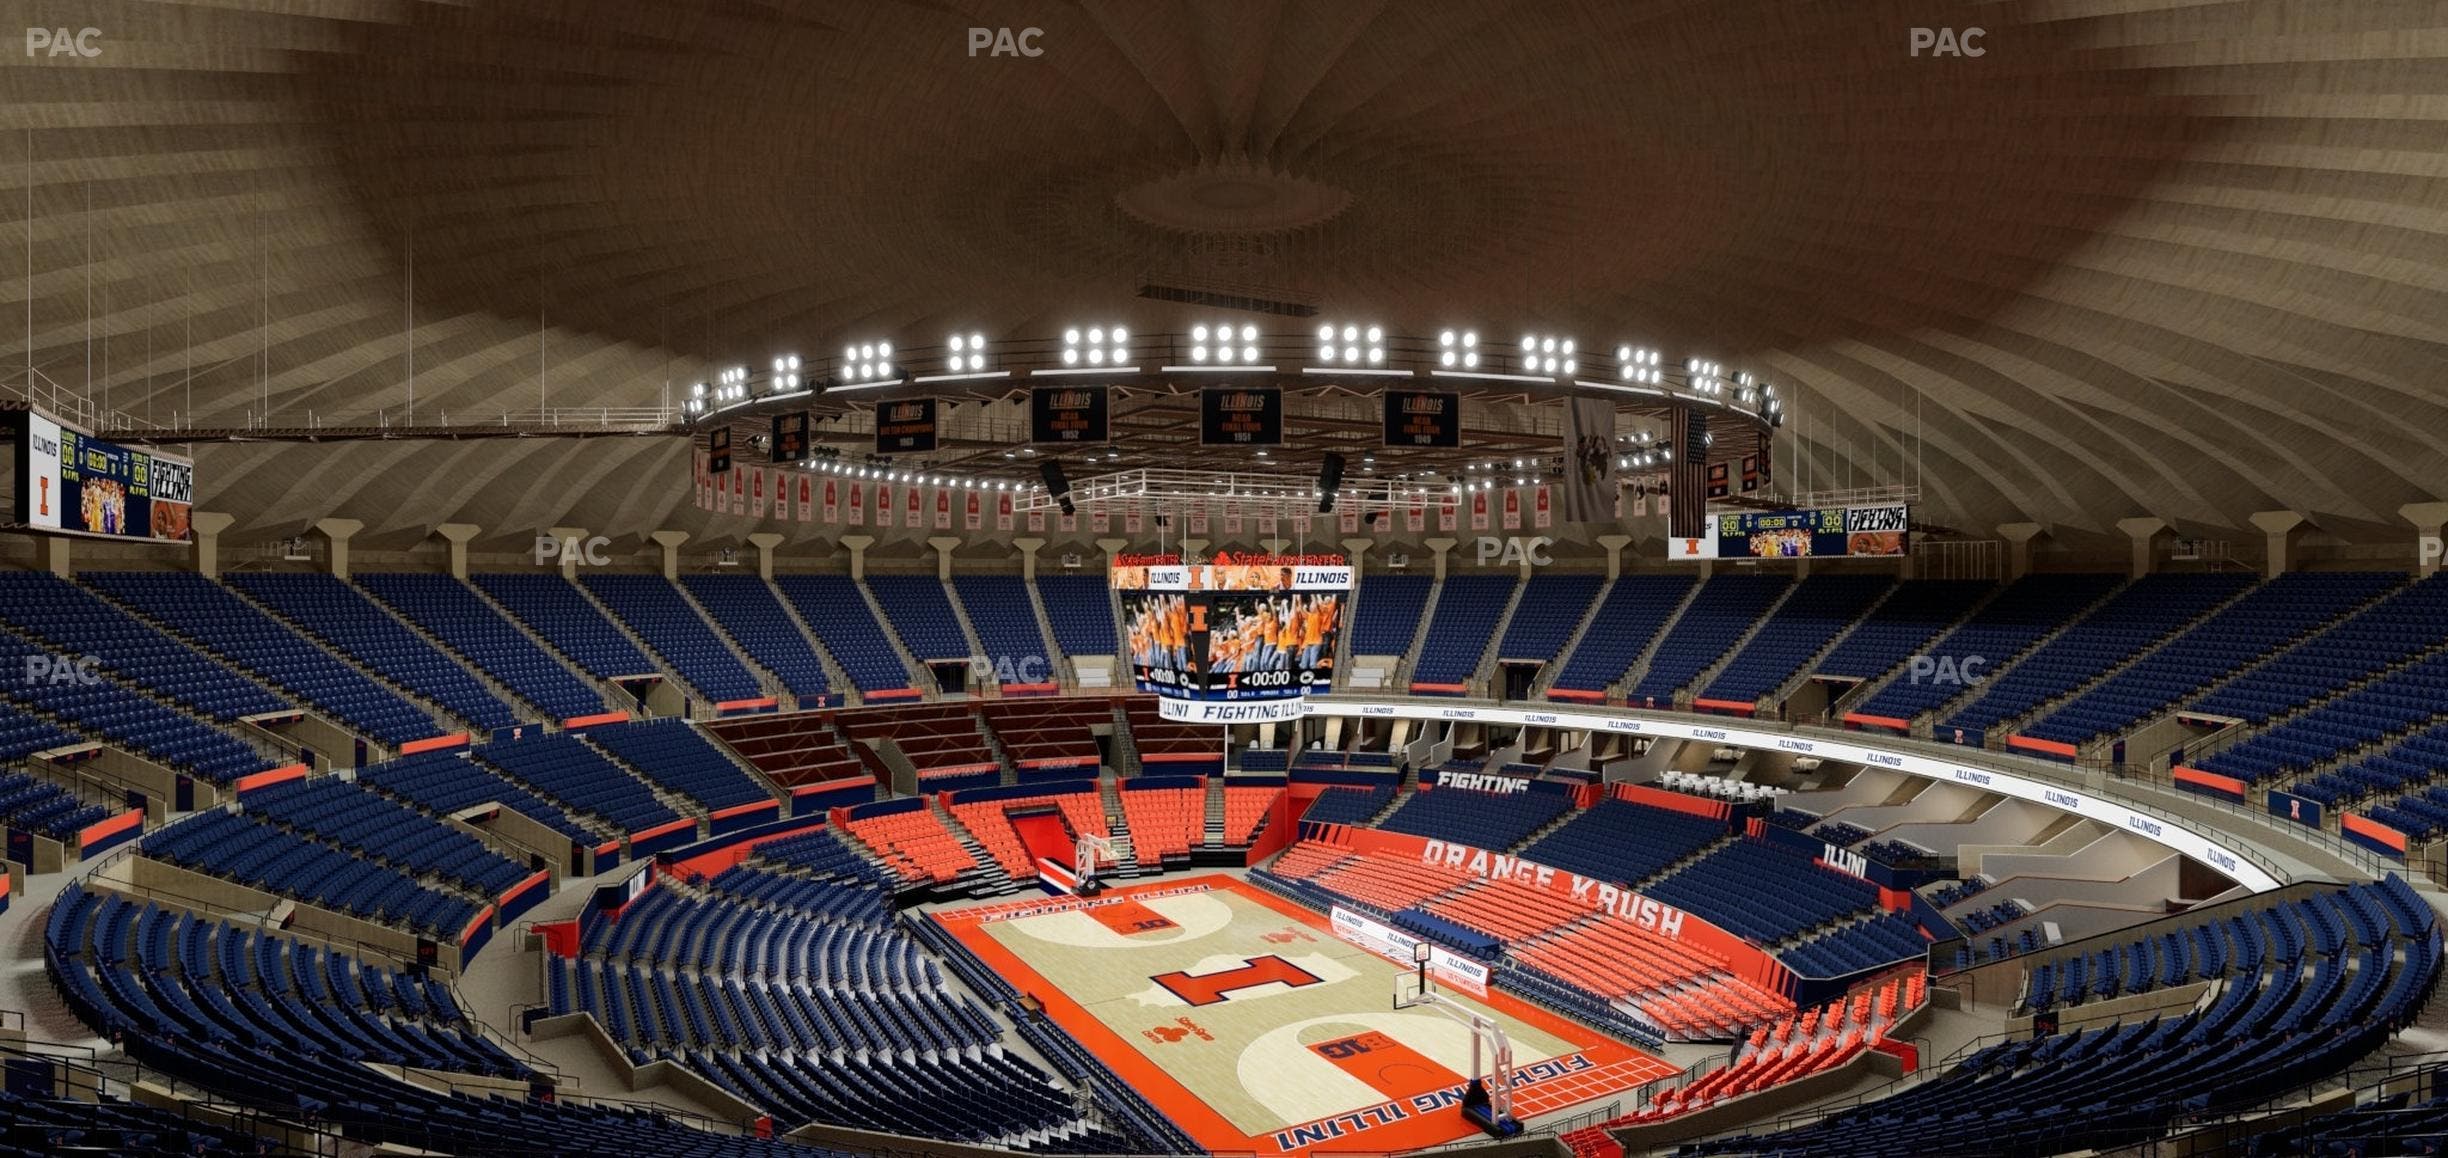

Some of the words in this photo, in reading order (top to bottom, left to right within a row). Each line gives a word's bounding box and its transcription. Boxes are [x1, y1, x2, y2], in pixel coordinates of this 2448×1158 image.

[1050, 392, 1092, 407] ILLINOIS
[1220, 394, 1265, 409] ILLINOIS
[1402, 396, 1444, 411] ILLINOIS
[33, 434, 57, 457] ILLINOIS
[1849, 506, 1904, 520] FIGHTING
[1849, 518, 1906, 532] ILLINI
[1151, 571, 1181, 584] ILLINOIS
[1295, 572, 1349, 584] ILLINOIS
[1252, 672, 1290, 686] 00:00
[1203, 703, 1279, 719] FIGHTING
[1362, 706, 1394, 715] ILLINOIS
[1443, 709, 1475, 719] ILLINOIS
[1525, 714, 1558, 724] ILLINOIS
[1607, 720, 1641, 731] ILLINOIS
[1692, 728, 1726, 741] ILLINOIS
[1778, 739, 1813, 752] ILLINOIS
[1866, 752, 1903, 767] ILLINOIS
[1437, 771, 1530, 794] FIGHTING
[1955, 768, 1991, 786] ILLINOIS
[2044, 789, 2079, 809] ILLINOIS
[2128, 815, 2163, 838] ILLINOIS
[1423, 839, 1555, 890] ORANGE
[1823, 843, 1868, 880] ILLINI
[2206, 846, 2237, 873] ILLINOIS
[1569, 873, 1685, 942] KRUSH
[1335, 911, 1364, 928] ILLINOIS
[1387, 932, 1415, 951] ILLINOI
[1446, 956, 1483, 978] ILLINOIS
[1412, 1053, 1598, 1116] FIGHNG
[1276, 1101, 1410, 1152] ILLINI
